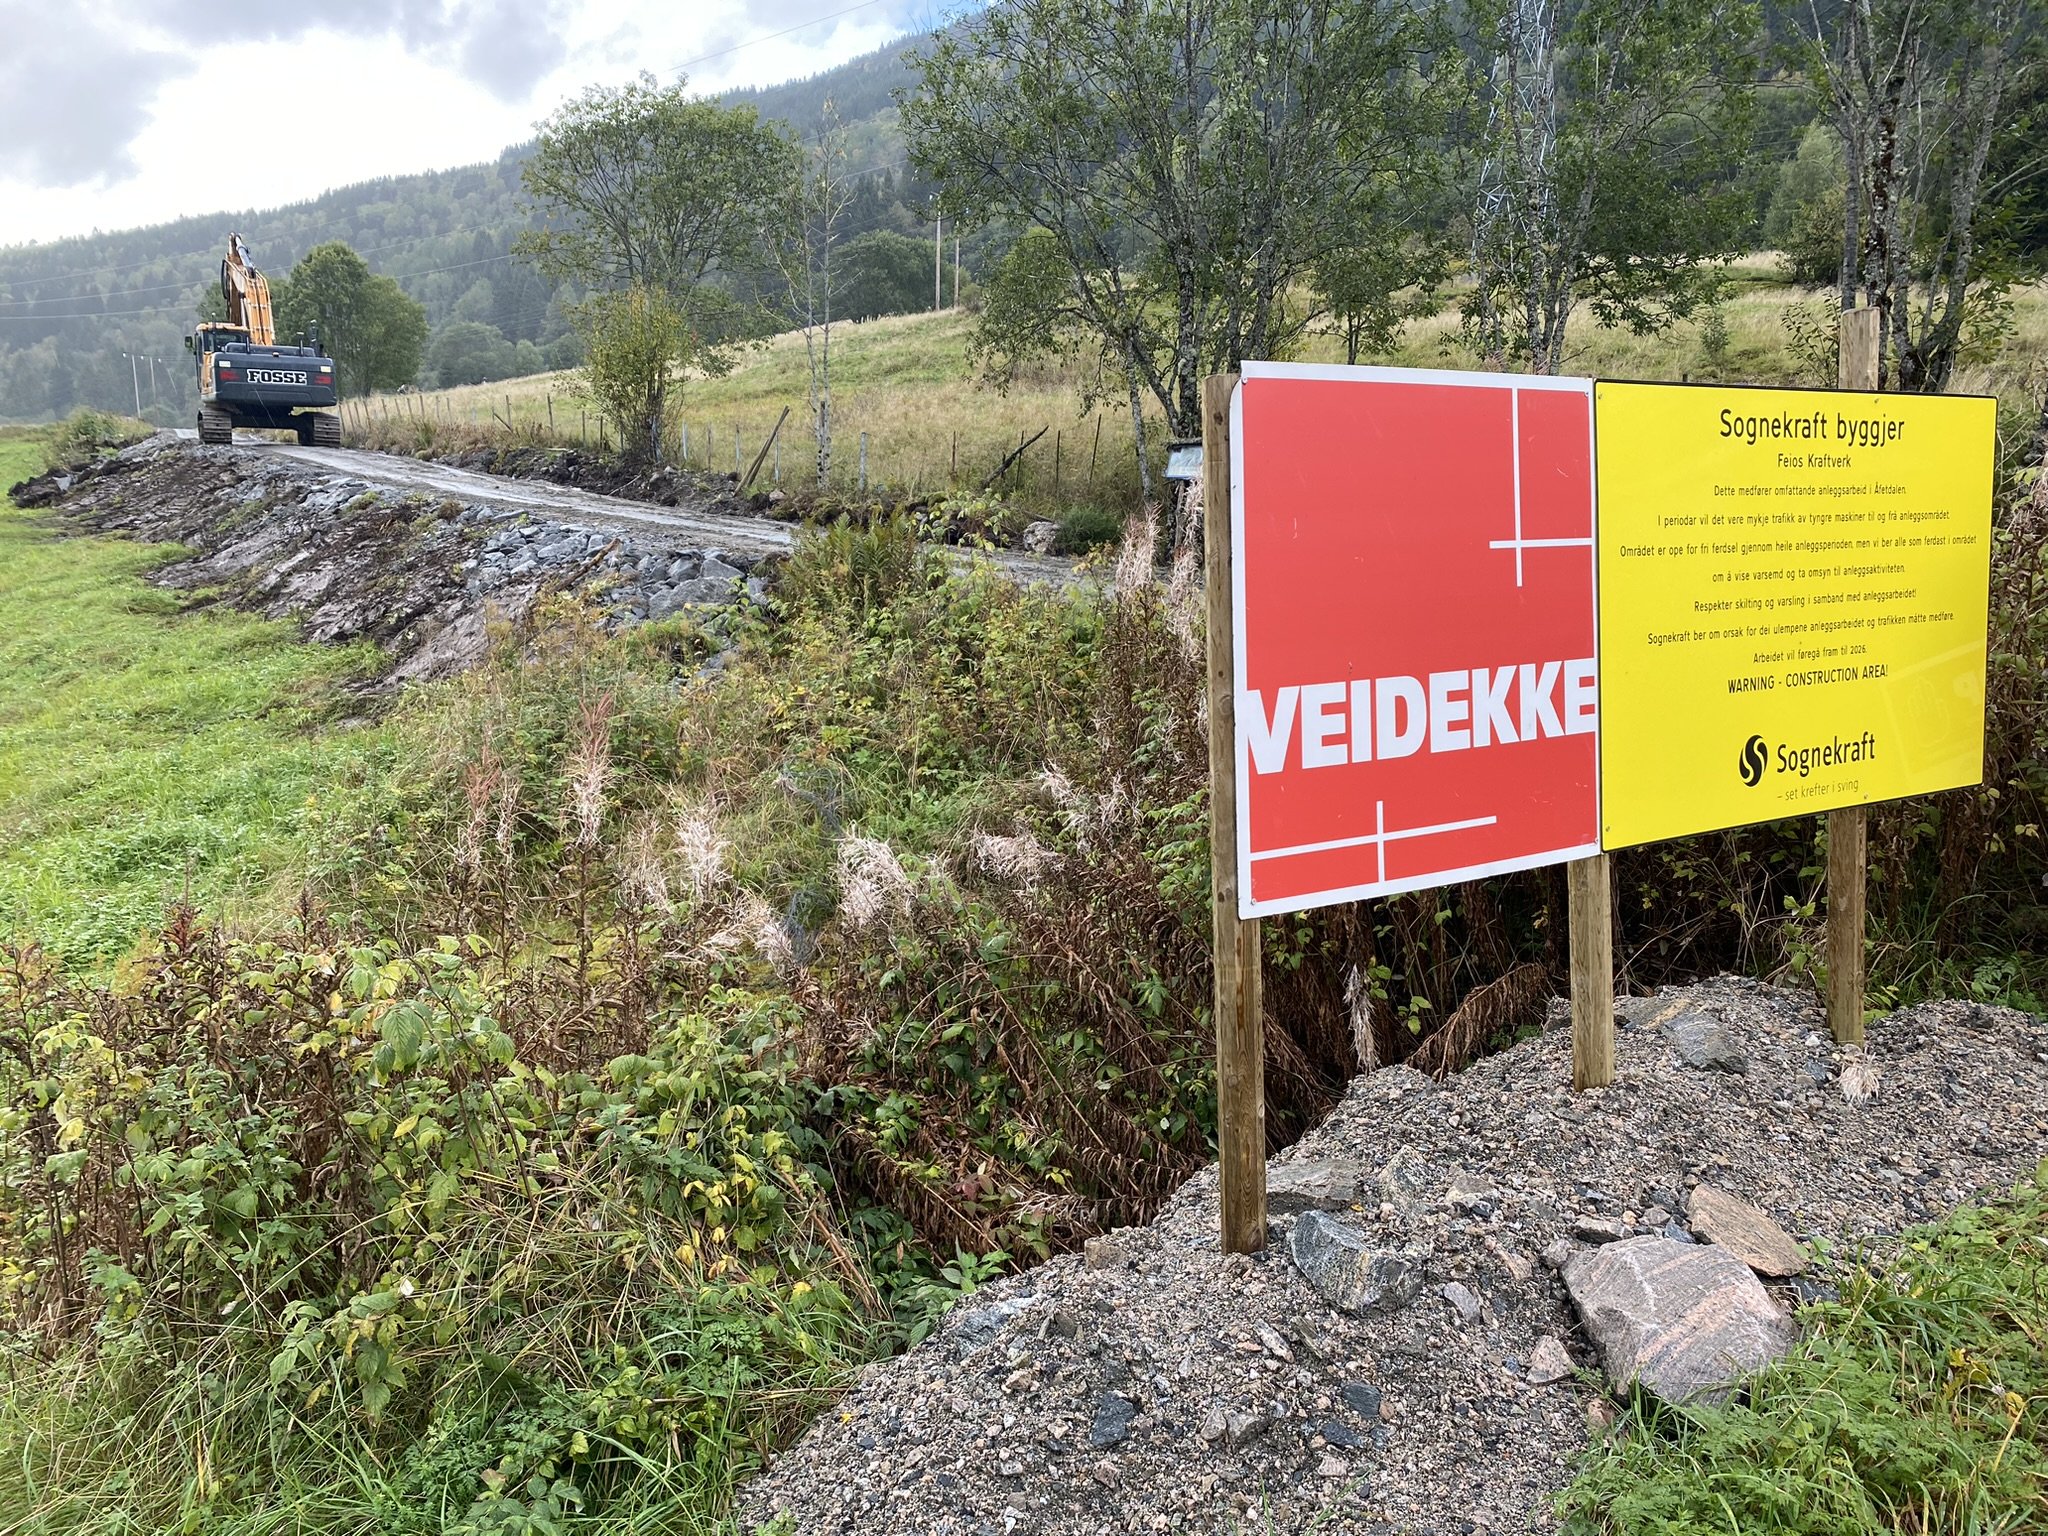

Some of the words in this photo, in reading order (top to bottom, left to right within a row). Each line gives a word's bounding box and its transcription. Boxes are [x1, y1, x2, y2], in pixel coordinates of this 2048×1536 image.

[247, 369, 307, 385] FOSSE
[1720, 409, 1827, 445] Sognekraft
[1837, 413, 1904, 447] byggjer
[1777, 452, 1804, 468] Feios
[1807, 453, 1852, 468] Kraftverk
[1714, 484, 1736, 497] Dette
[1738, 484, 1773, 496] medfører
[1774, 484, 1816, 496] omfattande
[1818, 483, 1867, 498] anleggsarbeid
[1664, 514, 1697, 529] periodar
[1699, 514, 1709, 526] vil
[1711, 514, 1725, 526] det
[1727, 516, 1744, 525] vere
[1746, 513, 1769, 528] mykje
[1771, 512, 1796, 524] trafikk
[1797, 514, 1807, 524] av
[1809, 513, 1833, 526] tyngre
[1834, 510, 1866, 522] maskiner
[1867, 511, 1875, 521] til
[1876, 513, 1886, 524] og
[1888, 510, 1898, 521] frå
[1619, 545, 1655, 558] Området
[1657, 546, 1667, 556] er
[1668, 546, 1684, 558] ope
[1686, 543, 1698, 555] for
[1700, 542, 1709, 554] fri
[1711, 542, 1738, 554] ferdsel
[1740, 541, 1773, 556] gjennom
[1775, 540, 1793, 552] heile
[1855, 540, 1871, 549] men
[1881, 537, 1893, 548] ber
[1894, 536, 1907, 547] alle
[1908, 538, 1922, 547] som
[1923, 535, 1946, 546] ferdast
[1712, 573, 1724, 583] om
[1734, 572, 1750, 582] vise
[1752, 568, 1784, 581] varsemd
[1785, 569, 1796, 582] og
[1798, 568, 1806, 579] ta
[1808, 568, 1832, 580] omsyn
[1833, 566, 1841, 577] til
[1694, 600, 1733, 614] Respekter
[1735, 598, 1763, 611] skilting
[1764, 598, 1775, 610] og
[1777, 595, 1805, 608] varsling
[1813, 592, 1844, 605] samband
[1846, 591, 1861, 602] med
[1862, 588, 1917, 603] anleggsarbeidet!
[1647, 630, 1691, 646] Sognekraft
[1693, 630, 1707, 641] ber
[1708, 630, 1721, 640] om
[1722, 627, 1744, 639] orsak
[1746, 625, 1757, 637] for
[1759, 625, 1771, 636] dei
[1773, 623, 1808, 636] ulempene
[1810, 618, 1865, 633] anleggsarbeidet
[1866, 618, 1876, 630] og
[1877, 615, 1906, 627] trafikken
[1908, 613, 1927, 624] måtte
[1753, 651, 1784, 663] Arbeidet
[1786, 649, 1795, 661] vil
[1797, 648, 1821, 661] føregå
[1822, 646, 1839, 657] fram
[1840, 645, 1848, 656] til
[1727, 674, 1775, 694] WARNING
[1785, 667, 1859, 688] CONSTRUCTION
[1861, 663, 1890, 680] AREA!
[1247, 658, 1597, 775] VEIDEKKE
[1777, 731, 1875, 777] Sognekraft
[1785, 788, 1798, 801] set
[1801, 782, 1830, 798] krefter
[1837, 779, 1859, 793] sving
